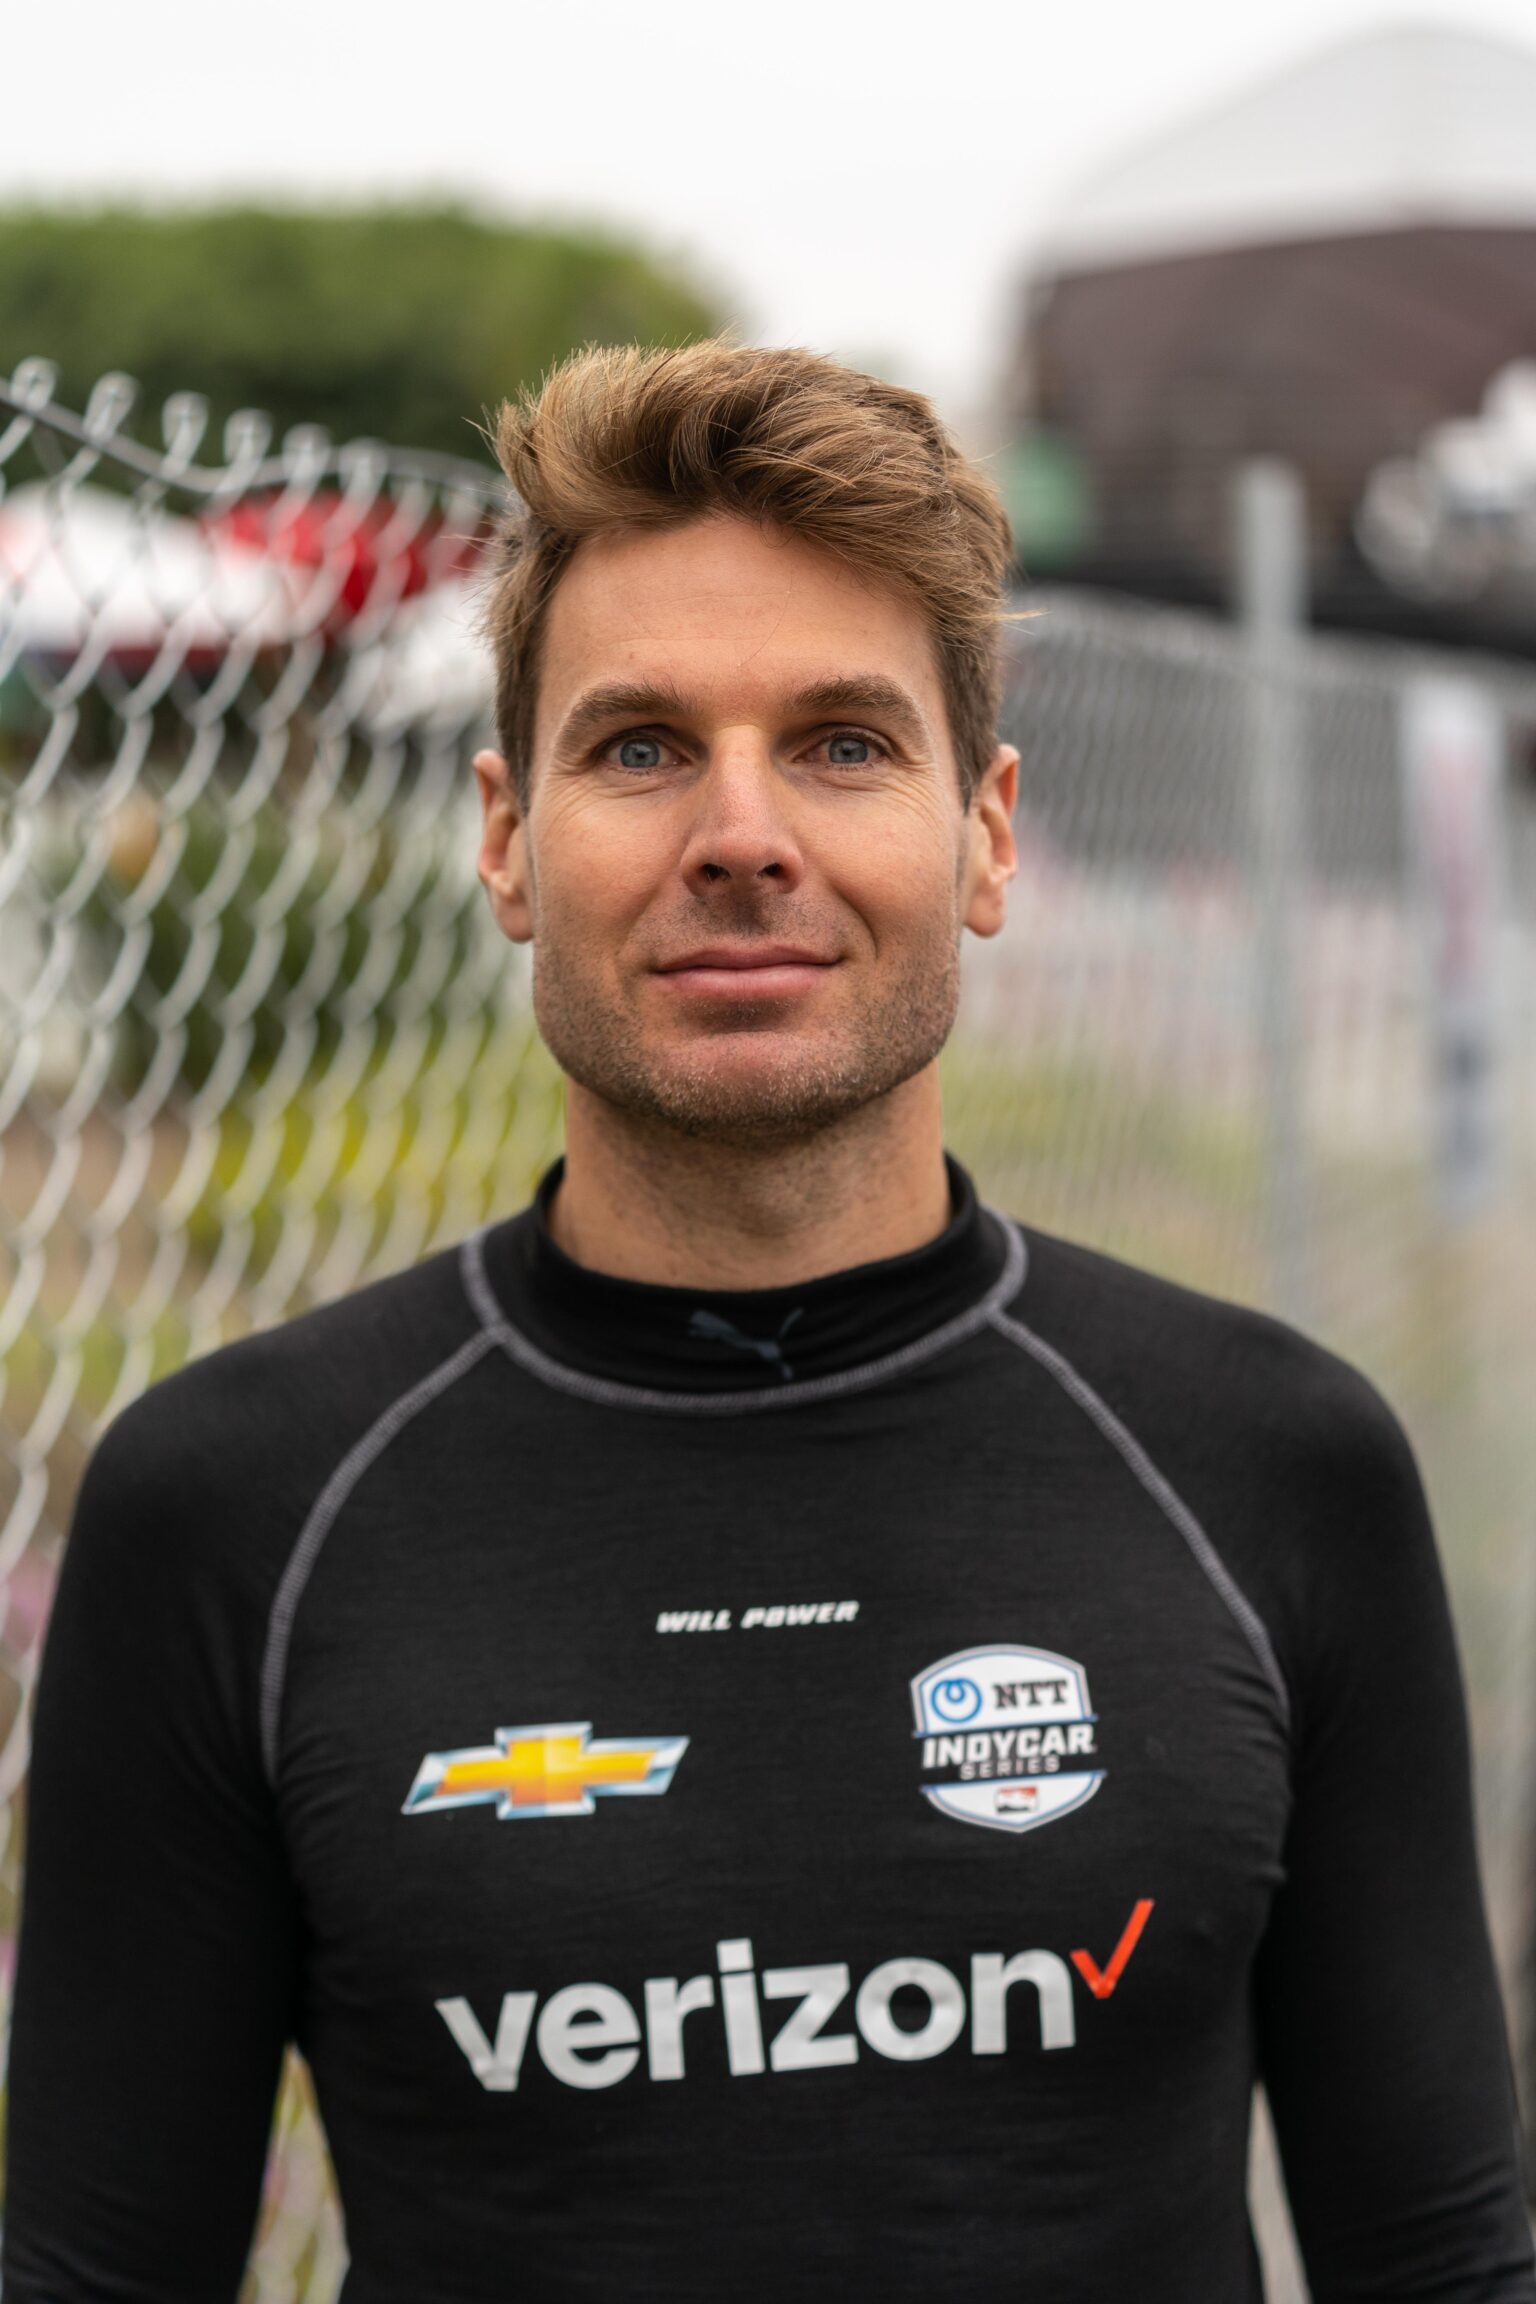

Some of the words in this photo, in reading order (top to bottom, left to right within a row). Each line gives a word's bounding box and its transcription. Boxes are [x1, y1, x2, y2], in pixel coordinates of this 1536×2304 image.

[656, 1609, 731, 1633] WILL
[740, 1600, 859, 1629] POWER
[994, 1678, 1067, 1709] NTT
[921, 1723, 1096, 1769] INDYCAR
[960, 1754, 1060, 1781] SERIES
[435, 1938, 1076, 2092] verizon
